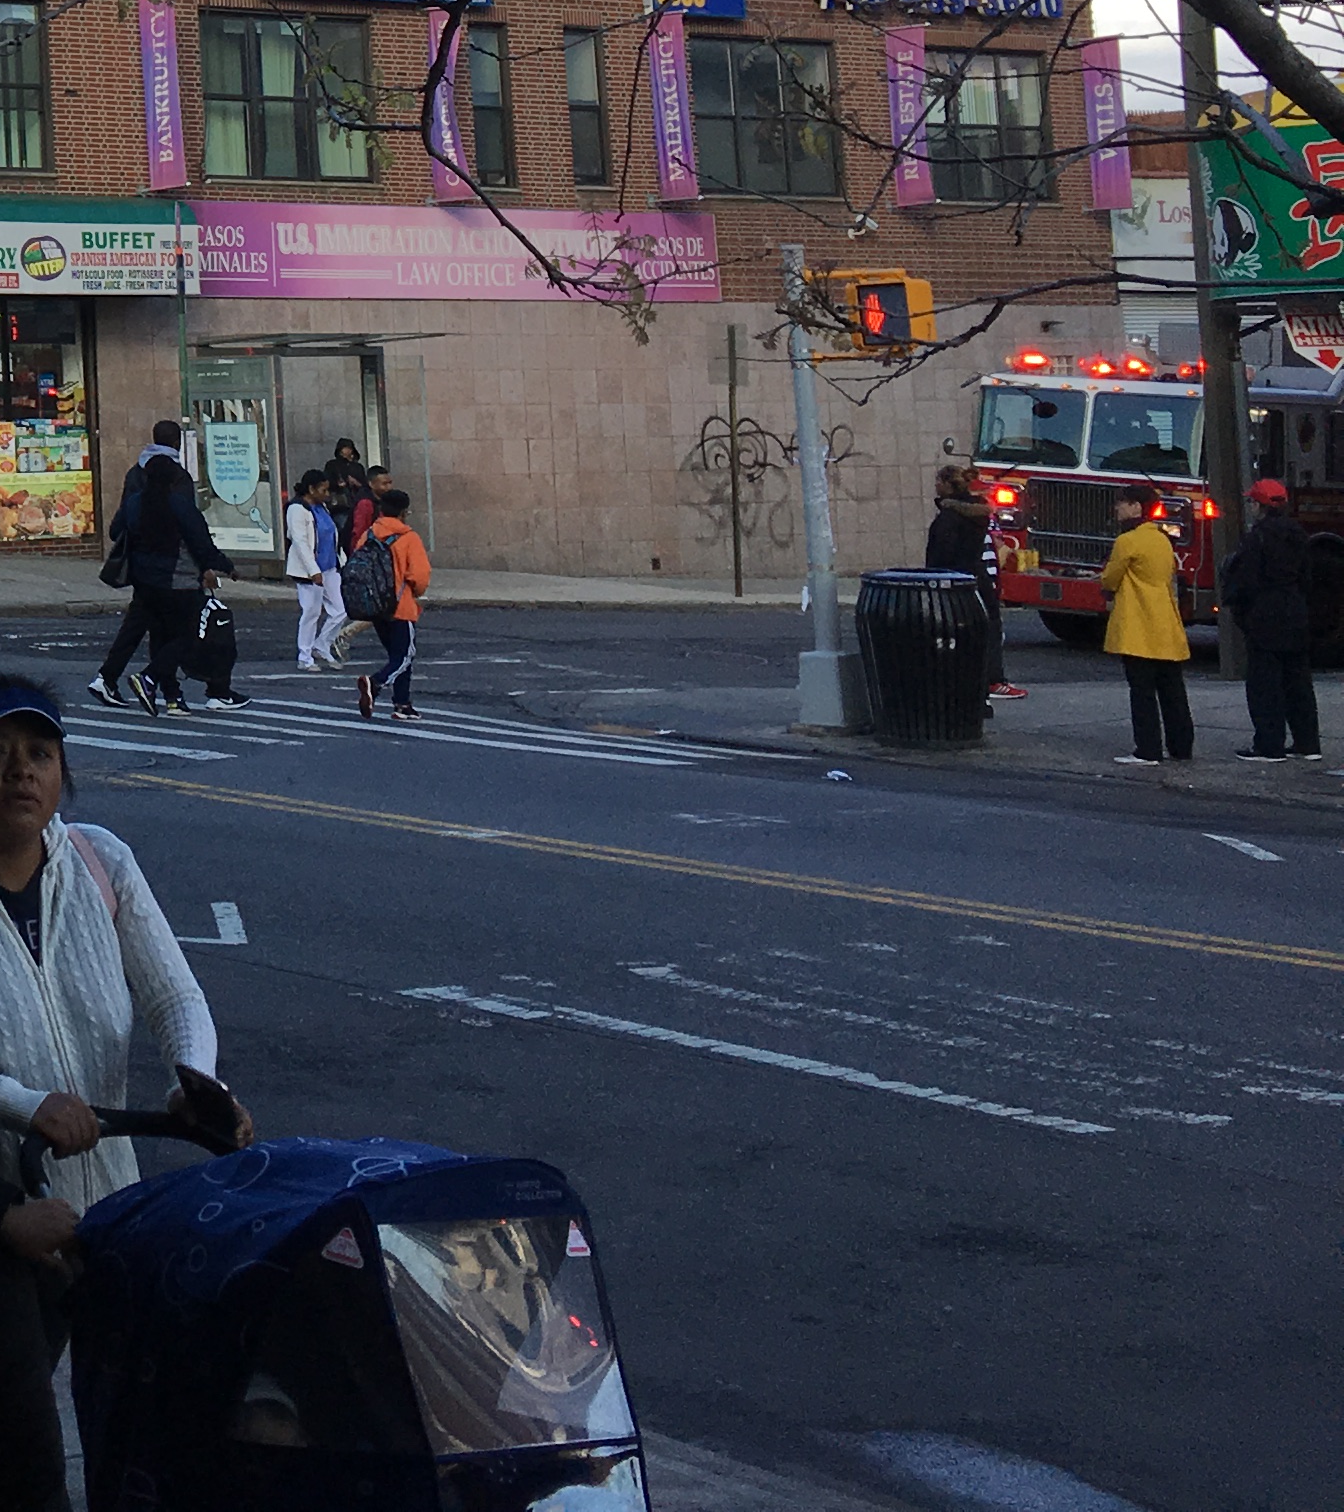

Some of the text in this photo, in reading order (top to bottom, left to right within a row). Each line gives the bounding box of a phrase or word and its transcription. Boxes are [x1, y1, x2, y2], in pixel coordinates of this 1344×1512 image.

[150, 8, 174, 164] BANKRUPTCY
[897, 49, 917, 125] ESTATE
[658, 30, 685, 182] MALPRACTICE
[81, 231, 156, 250] BUFFET
[198, 224, 245, 248] CASOS
[275, 222, 314, 255] U.S.
[315, 223, 453, 256] IMMIGRATION
[638, 237, 705, 257] ASOS DE
[70, 252, 193, 268] SPANISH AMERICAN FOD
[633, 259, 716, 281] ACCIDENTES
[82, 280, 102, 290] FRESH
[124, 280, 145, 290] FRESH
[167, 271, 195, 280] CHEN
[396, 262, 516, 288] LAW OFFICE
[1292, 315, 1344, 336] ATM
